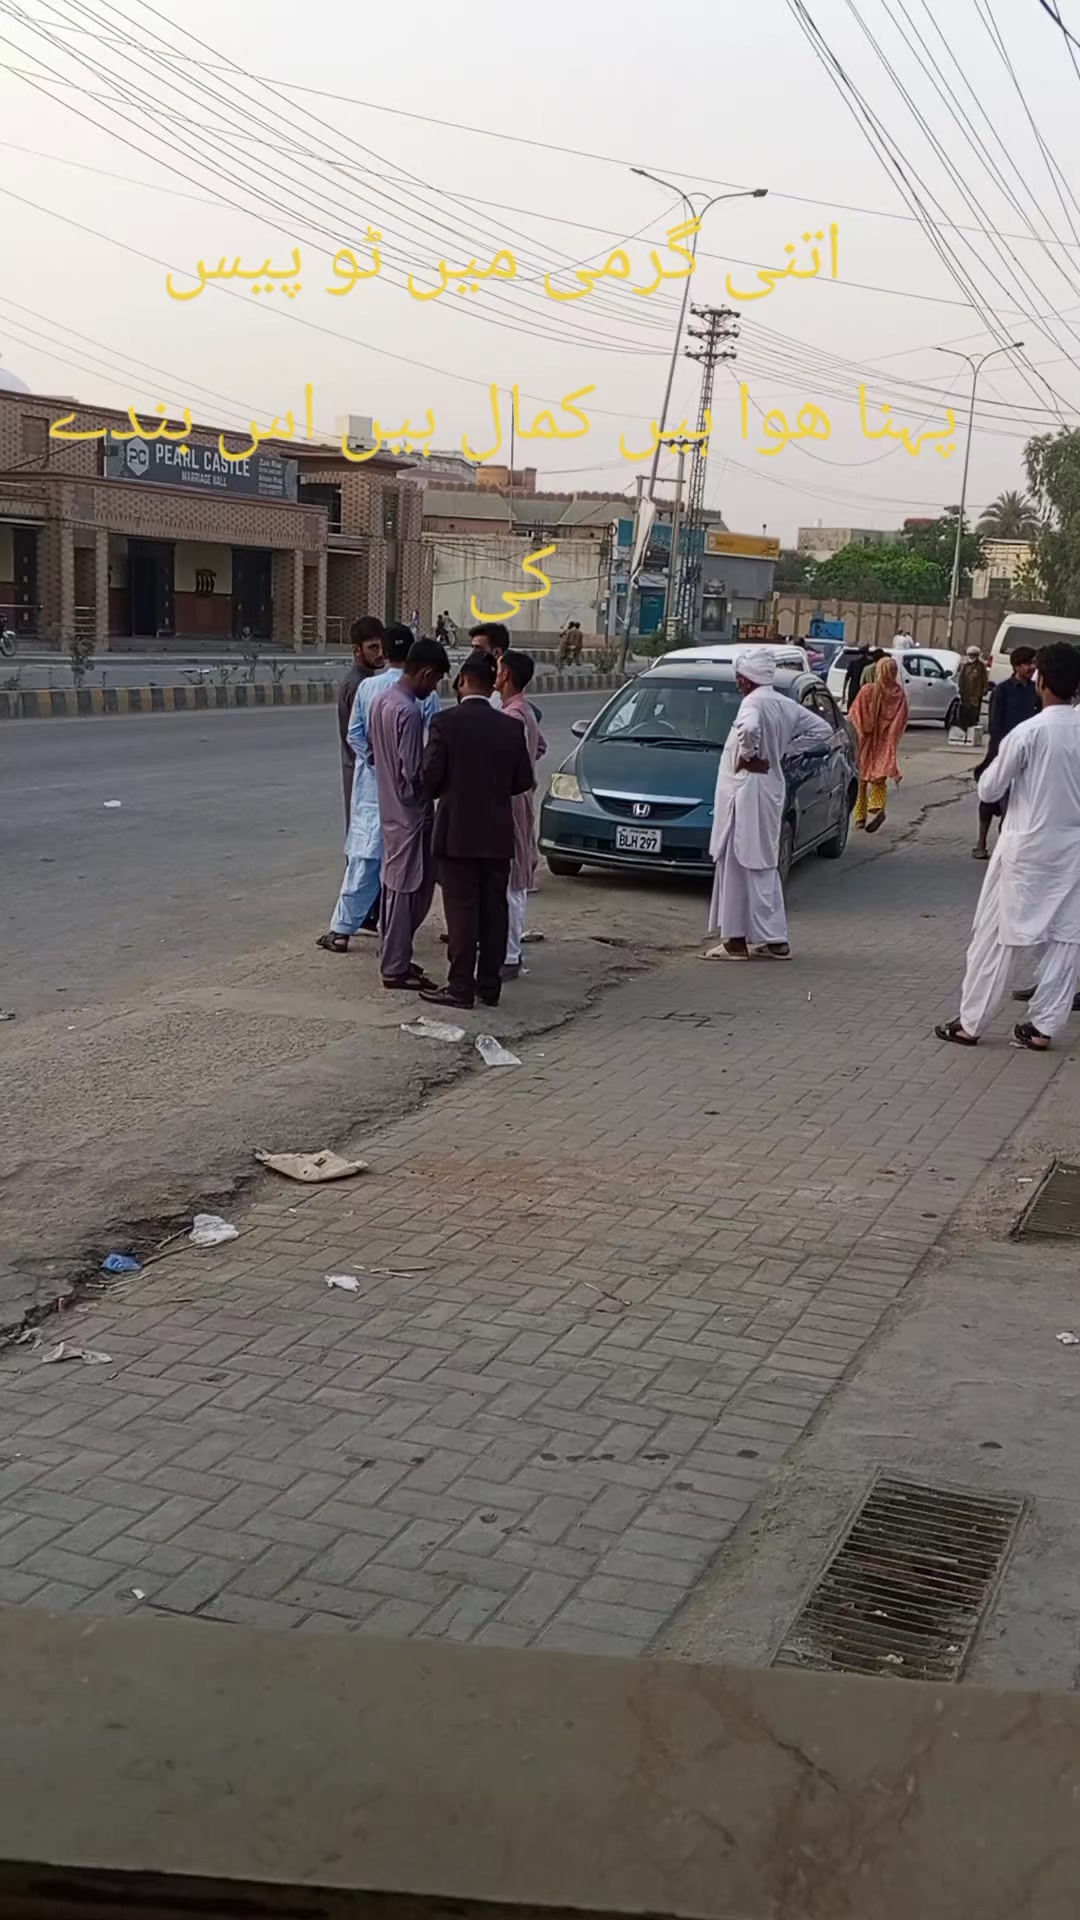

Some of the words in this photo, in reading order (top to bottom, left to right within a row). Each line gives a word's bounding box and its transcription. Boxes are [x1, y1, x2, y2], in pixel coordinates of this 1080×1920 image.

[155, 443, 200, 470] PEARL
[203, 451, 251, 477] CASTLE
[619, 833, 639, 849] BLH
[639, 836, 658, 850] 297
